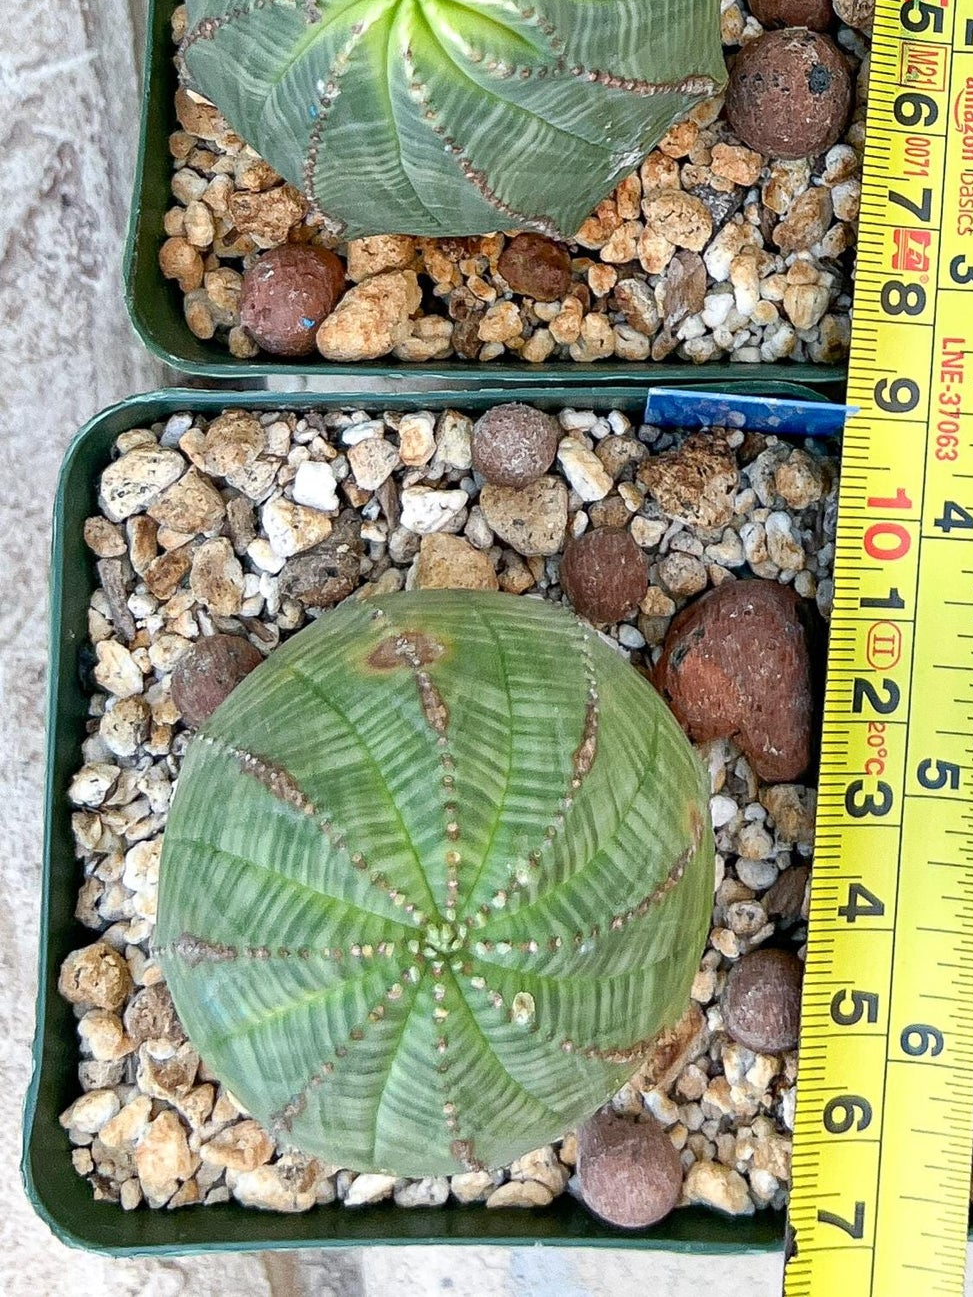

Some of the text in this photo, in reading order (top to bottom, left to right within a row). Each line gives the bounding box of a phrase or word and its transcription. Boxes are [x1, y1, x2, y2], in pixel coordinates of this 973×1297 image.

[900, 0, 943, 33] 5
[893, 92, 938, 127] 6
[903, 137, 931, 176] 0071
[888, 188, 932, 222] 7
[881, 280, 926, 315] 8
[874, 378, 920, 413] 9
[935, 337, 965, 461] LNE-37063
[860, 588, 905, 610] 1
[852, 677, 900, 715] 2
[917, 758, 960, 790] 5
[845, 779, 893, 818] 3
[838, 883, 884, 923] 4
[830, 989, 878, 1026] 5
[900, 1024, 944, 1057] 6
[823, 1095, 872, 1134] 6
[818, 1201, 865, 1239] 7
